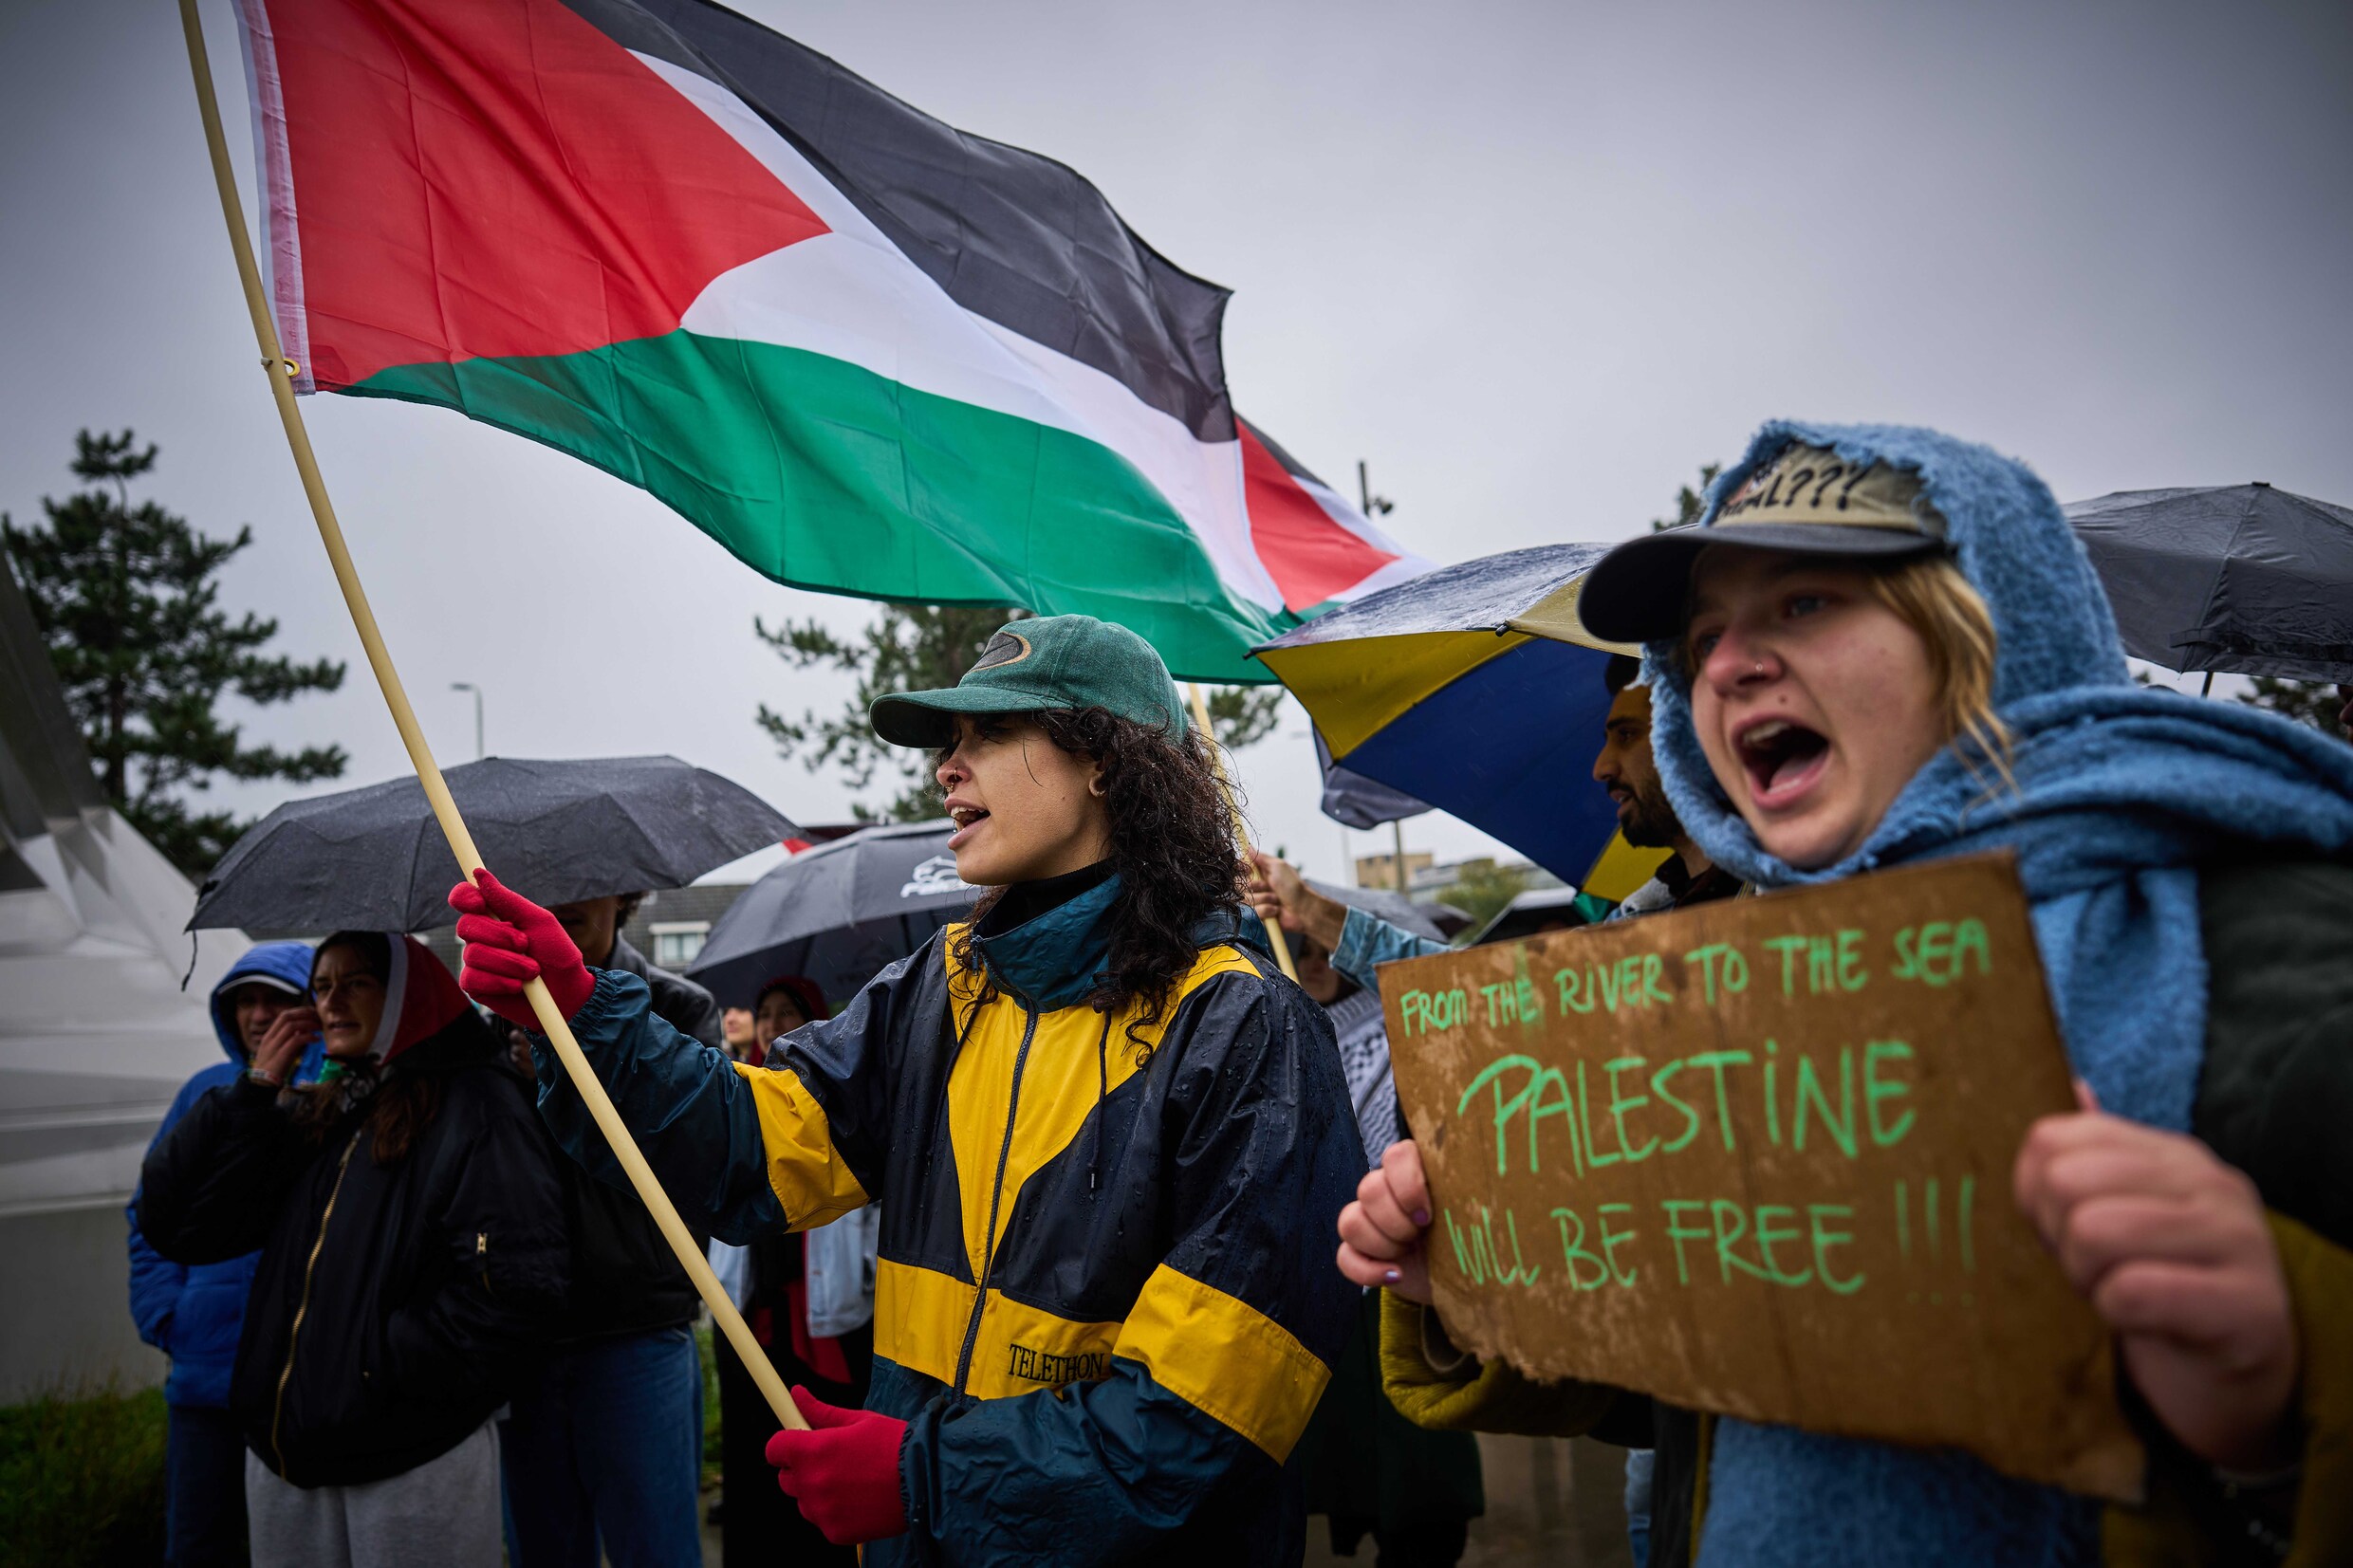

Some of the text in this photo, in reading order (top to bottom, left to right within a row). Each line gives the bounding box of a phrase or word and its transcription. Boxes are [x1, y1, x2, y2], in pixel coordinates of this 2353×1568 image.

[1399, 987, 1468, 1039] FROM
[1480, 978, 1539, 1028] THE
[1684, 942, 1750, 1005] TO
[1763, 929, 1868, 996] THE
[1892, 916, 1992, 987] SEA
[1550, 1204, 1638, 1291] BE
[1661, 1199, 1866, 1294] FREE
[1896, 1174, 1975, 1307] !!!
[1009, 1343, 1104, 1383] TELETHON
